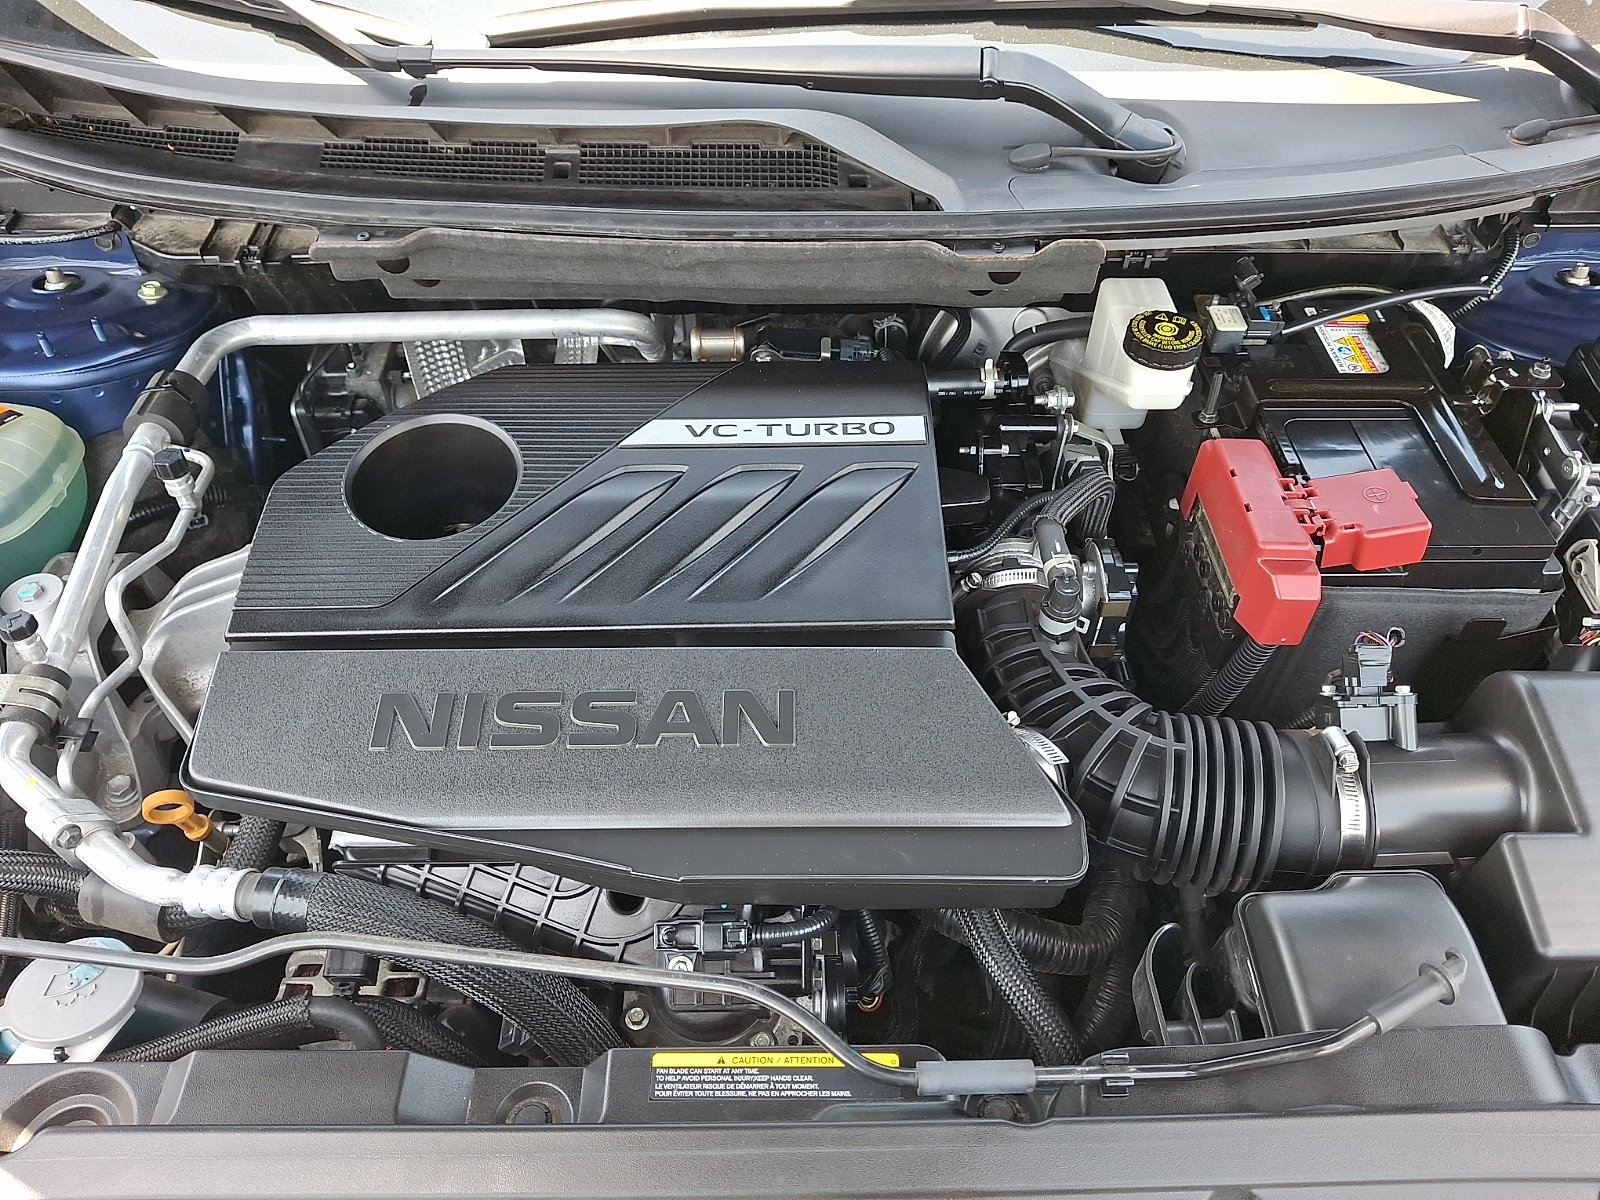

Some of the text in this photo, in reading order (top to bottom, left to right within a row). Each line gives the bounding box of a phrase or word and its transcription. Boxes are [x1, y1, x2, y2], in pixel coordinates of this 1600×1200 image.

[685, 421, 896, 438] VC-TURBO
[368, 688, 796, 750] NISSAN
[731, 1056, 774, 1065] CAUTION
[783, 1056, 835, 1065] ATTENTION
[736, 1082, 769, 1090] DÉMARRER
[655, 1090, 672, 1098] POUR
[673, 1089, 694, 1098] ÉVITER
[694, 1090, 714, 1098] TOUTE
[714, 1090, 748, 1098] BLESSURE,
[748, 1090, 757, 1098] NE
[757, 1090, 770, 1098] PAS
[771, 1090, 780, 1098] EN
[780, 1090, 818, 1098] APPROCHER
[819, 1090, 831, 1098] LES
